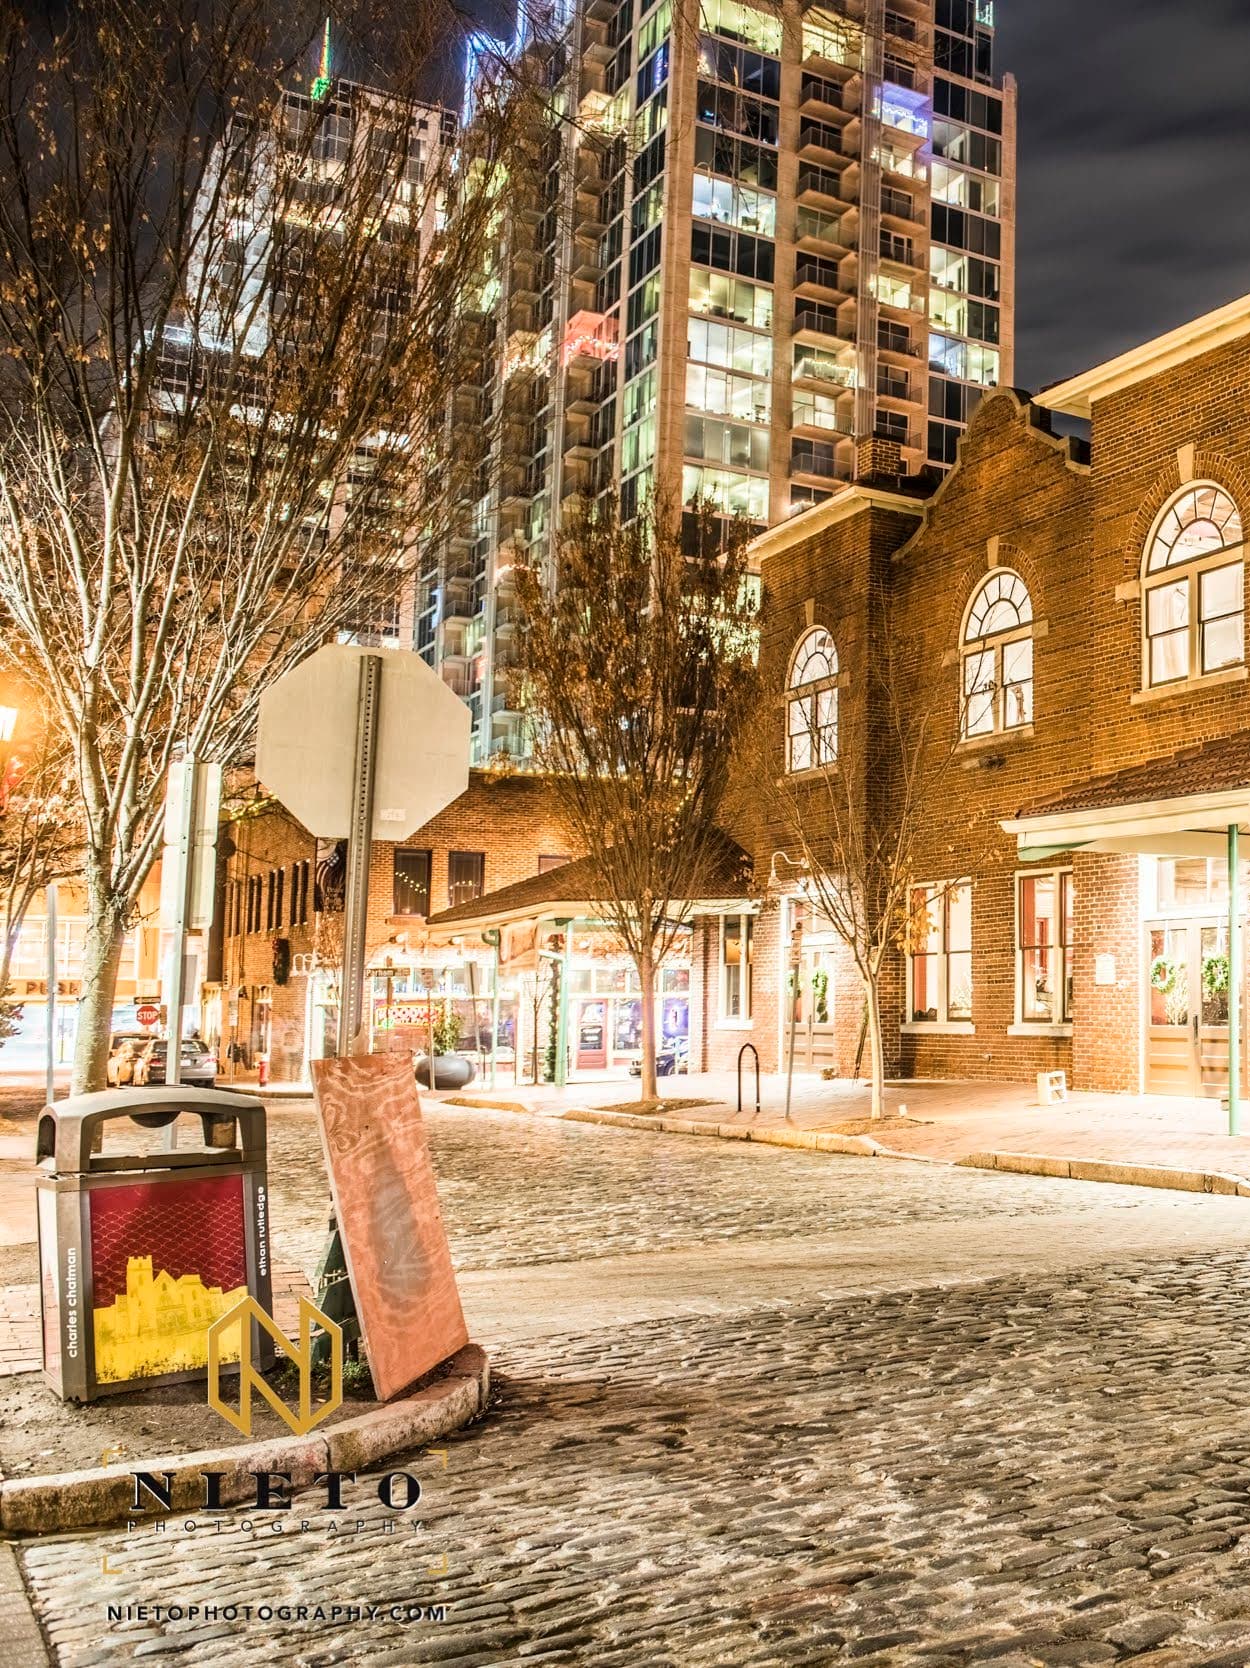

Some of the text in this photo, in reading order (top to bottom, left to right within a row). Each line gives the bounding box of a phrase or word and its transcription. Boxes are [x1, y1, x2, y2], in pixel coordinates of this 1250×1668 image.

[137, 1011, 158, 1020] STOP
[255, 1186, 267, 1277] ethan rutledge
[67, 1247, 79, 1358] charles chatman
